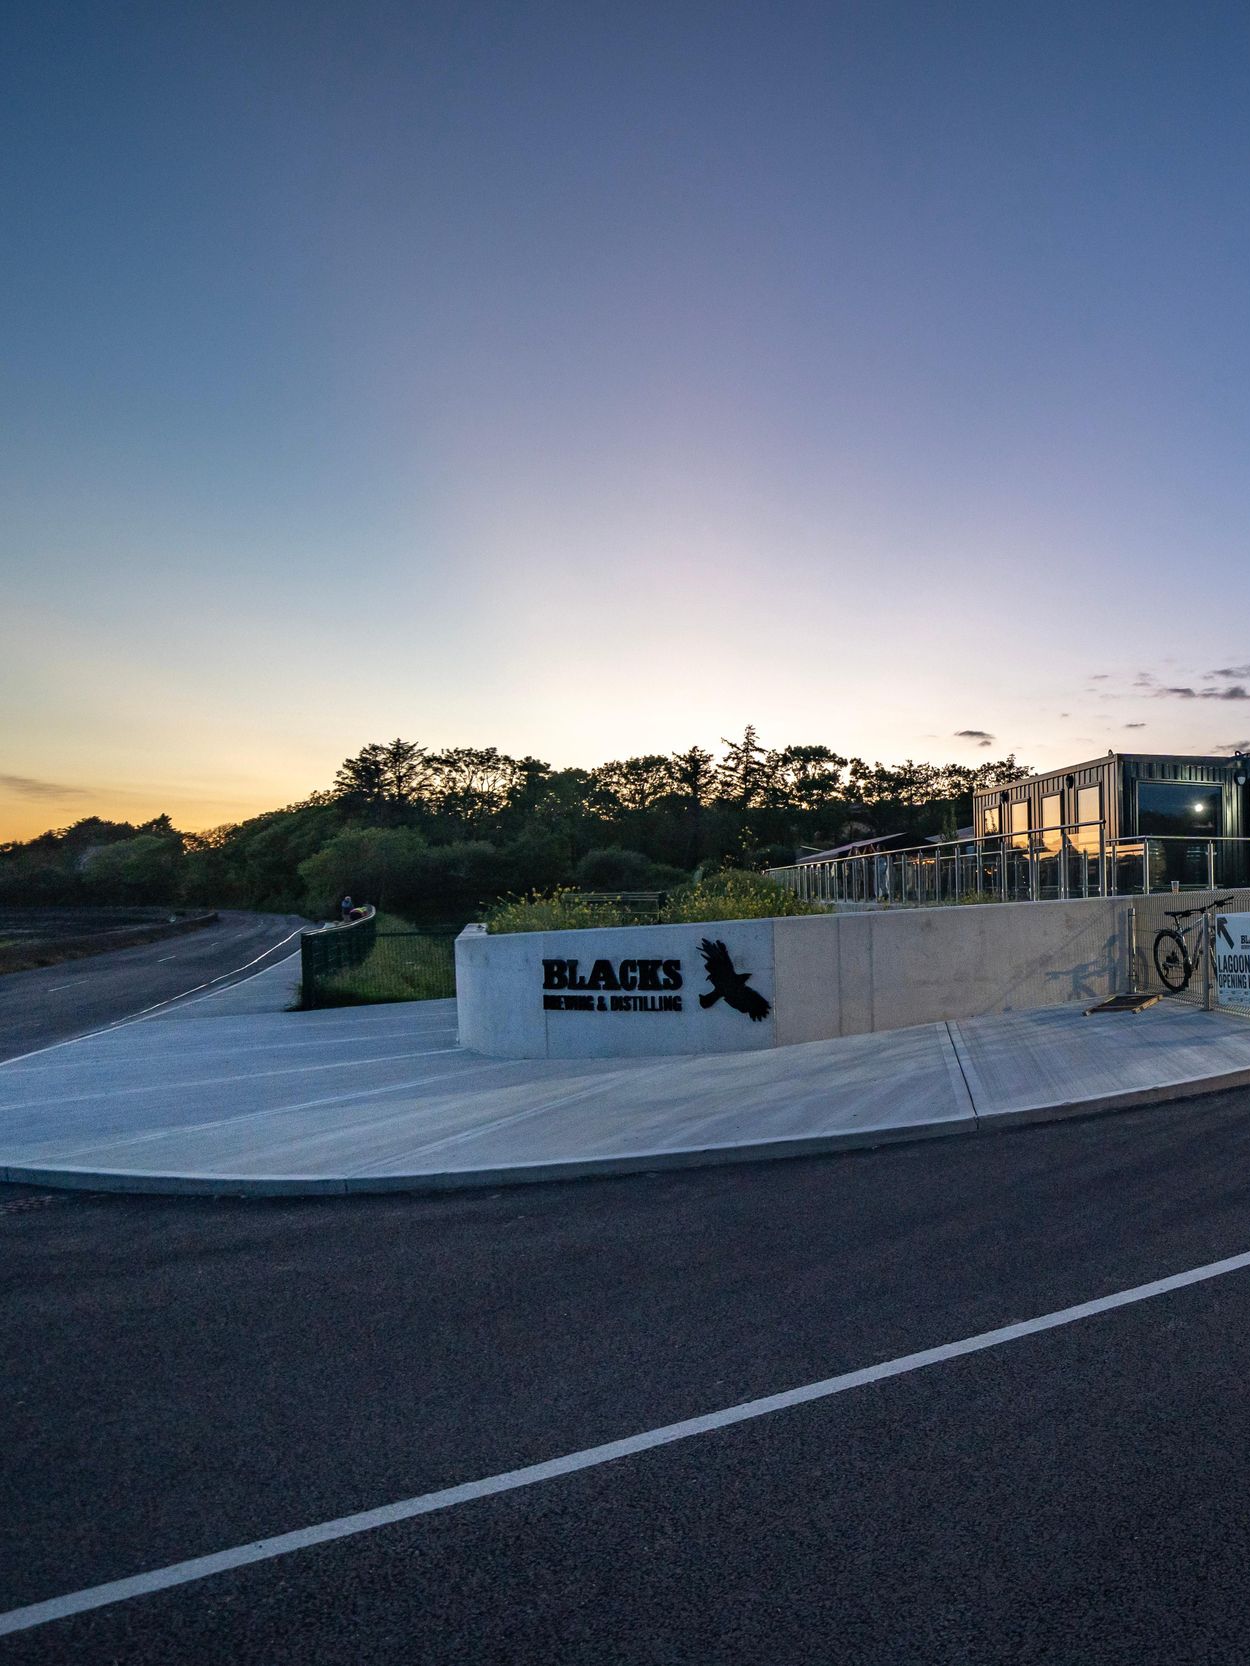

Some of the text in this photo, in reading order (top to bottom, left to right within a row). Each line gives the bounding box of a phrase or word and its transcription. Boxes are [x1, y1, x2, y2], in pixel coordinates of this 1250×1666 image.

[1218, 955, 1250, 973] LAGOON
[542, 959, 683, 991] BLACKS
[1219, 974, 1247, 988] OPENING
[597, 996, 608, 1011] &
[610, 996, 683, 1012] DISTILLING
